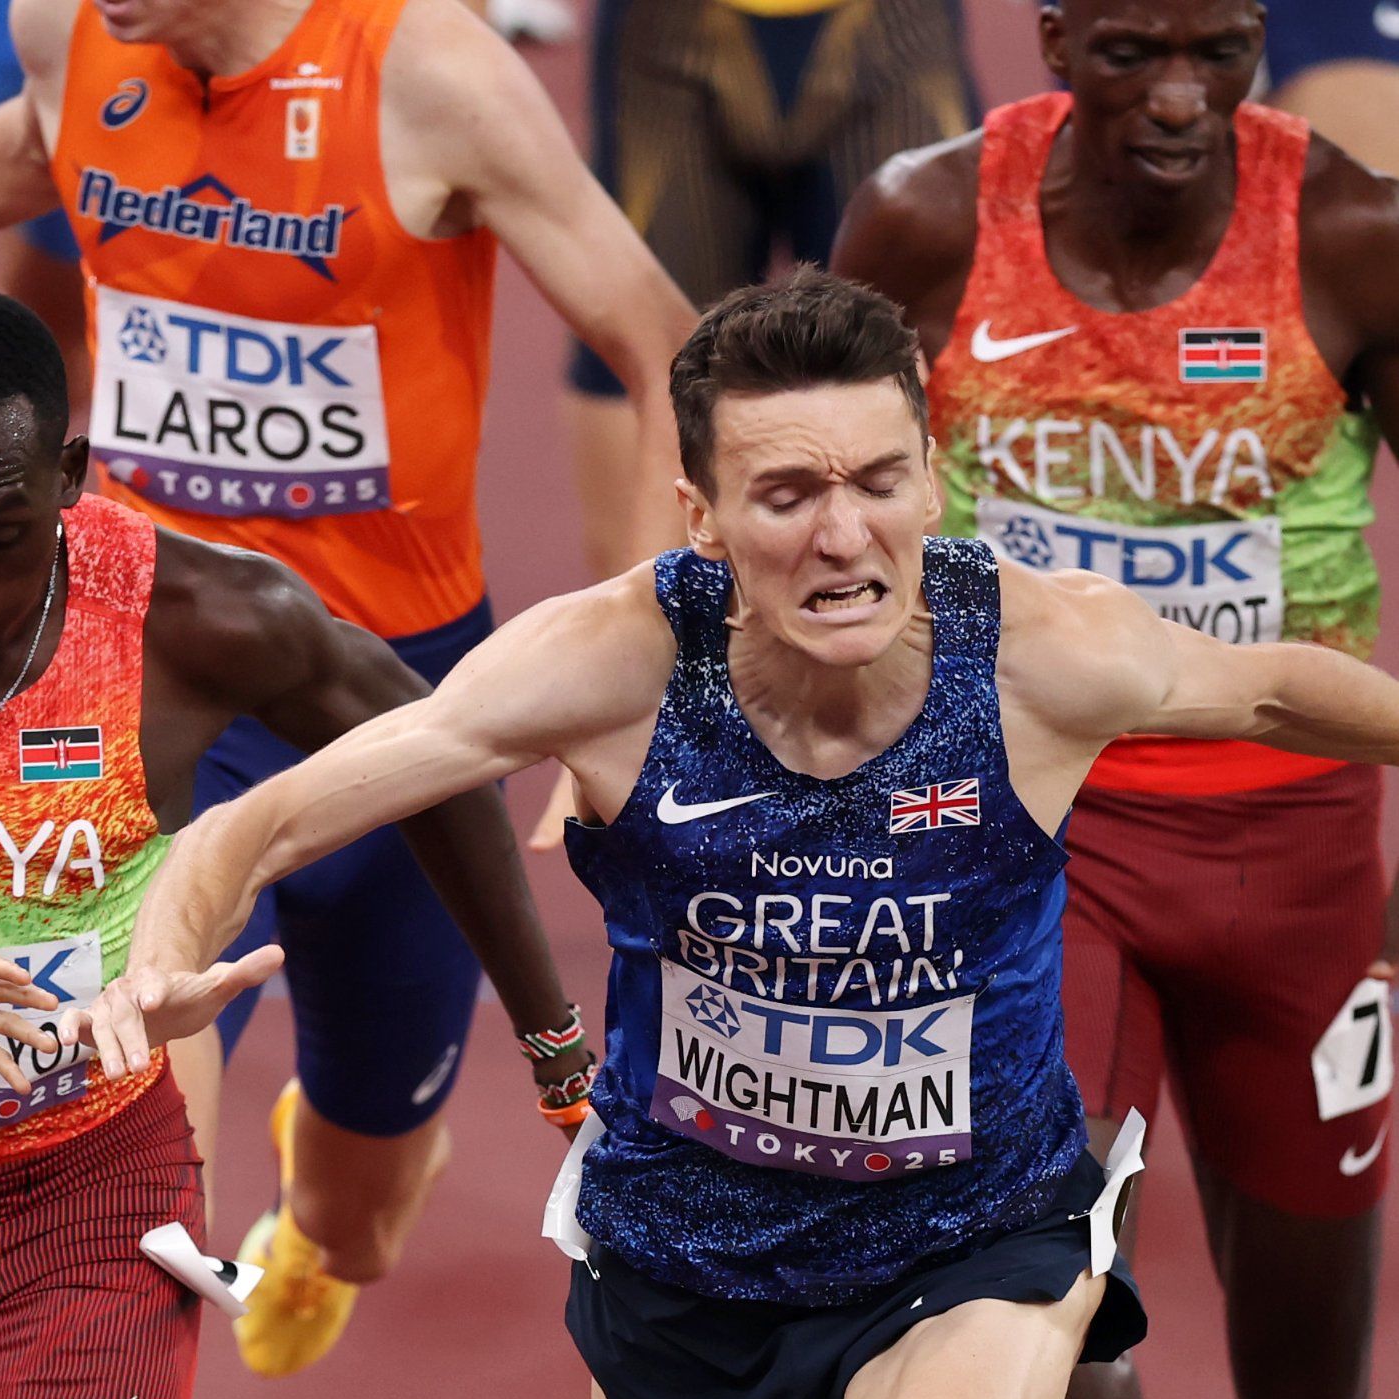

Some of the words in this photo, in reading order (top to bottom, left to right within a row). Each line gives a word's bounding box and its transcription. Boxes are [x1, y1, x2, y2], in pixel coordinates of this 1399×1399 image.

[168, 314, 352, 388] TDK
[114, 378, 365, 462] LAROS
[324, 477, 378, 503] 25
[976, 414, 1275, 504] KENYA
[1054, 524, 1255, 586] TDK
[751, 851, 894, 879] Novuna
[686, 891, 952, 955] GREAT
[677, 928, 964, 1006] BRITAIN
[740, 1003, 951, 1067] TDK
[29, 1072, 73, 1107] 25
[674, 1028, 954, 1137] WIGHTMAN
[905, 1147, 957, 1171] 25
